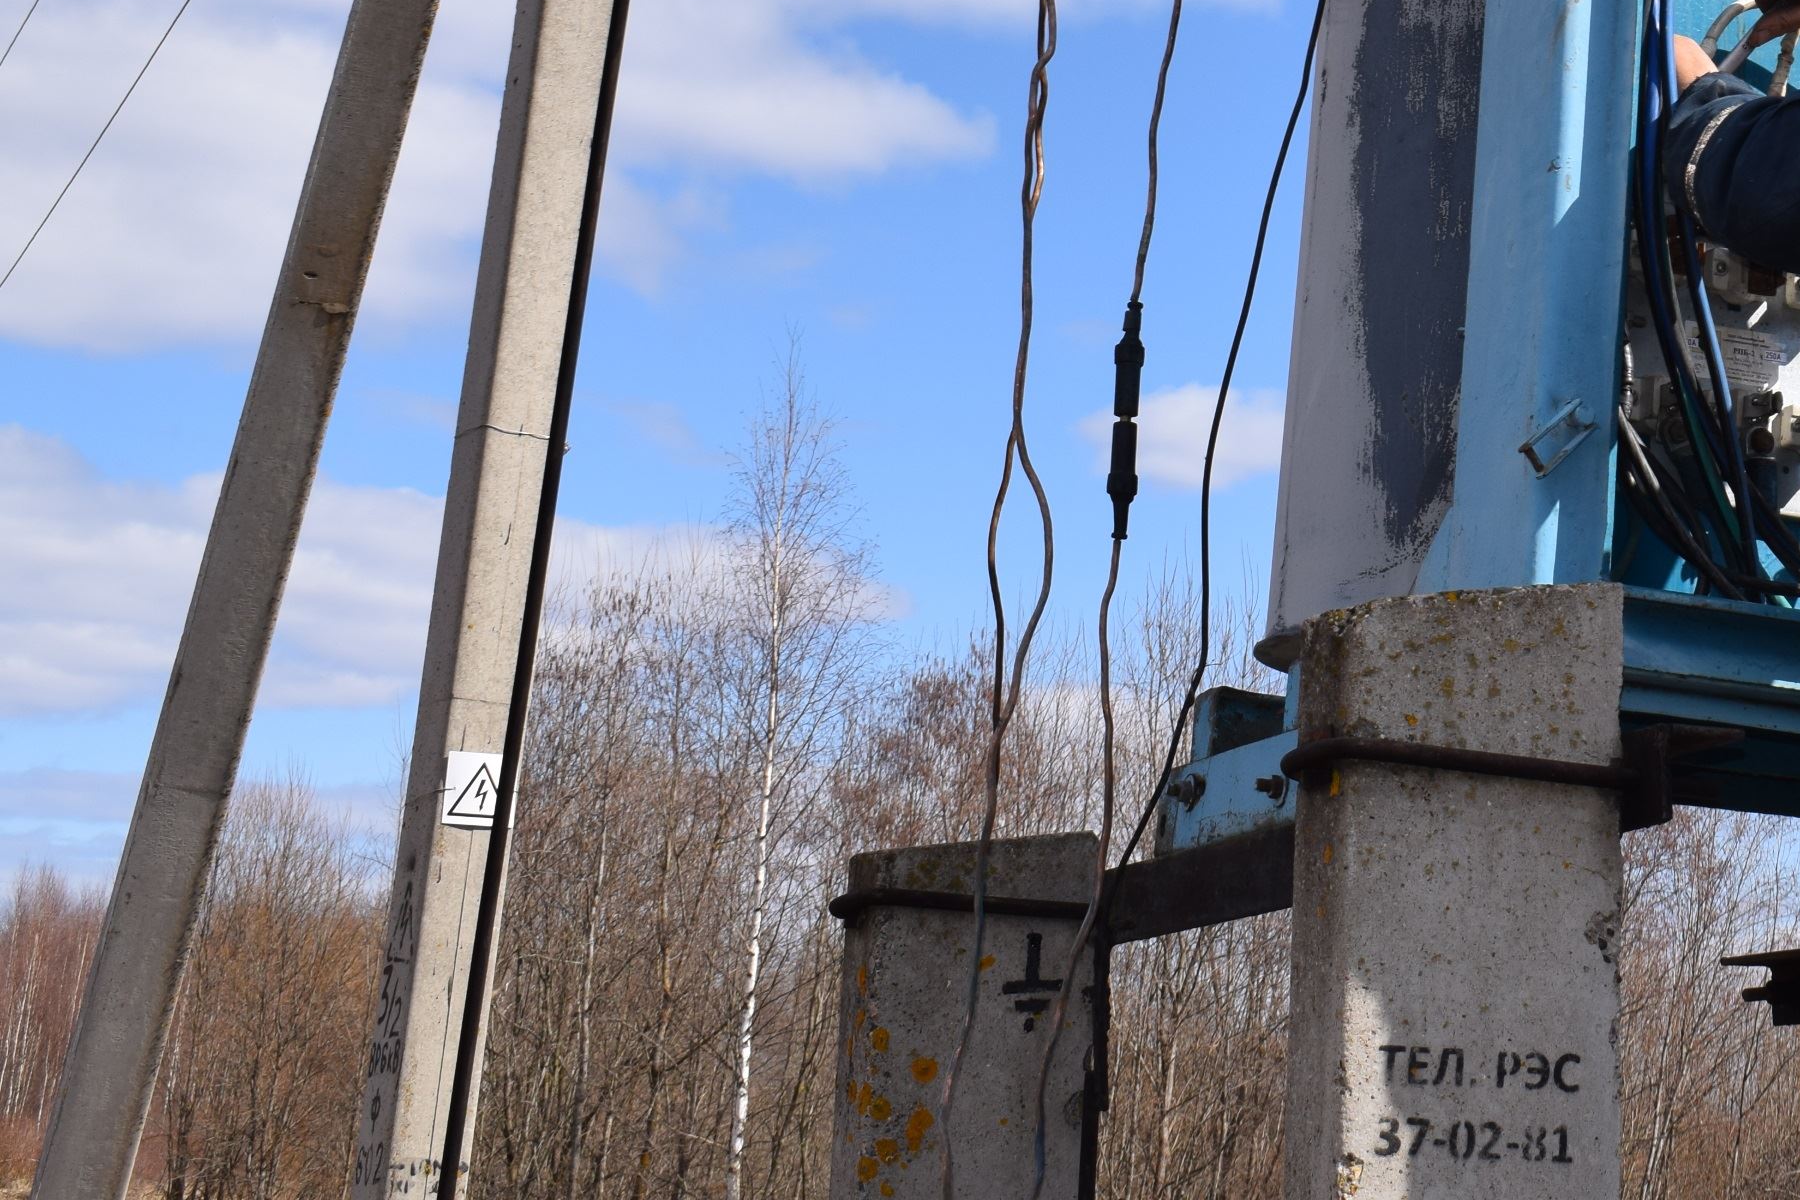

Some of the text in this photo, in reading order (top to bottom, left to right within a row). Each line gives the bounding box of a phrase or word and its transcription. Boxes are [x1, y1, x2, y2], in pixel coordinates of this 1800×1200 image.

[1379, 1045, 1581, 1092] ТЕЛ. РЭС
[1374, 1116, 1573, 1163] 37-02-81
